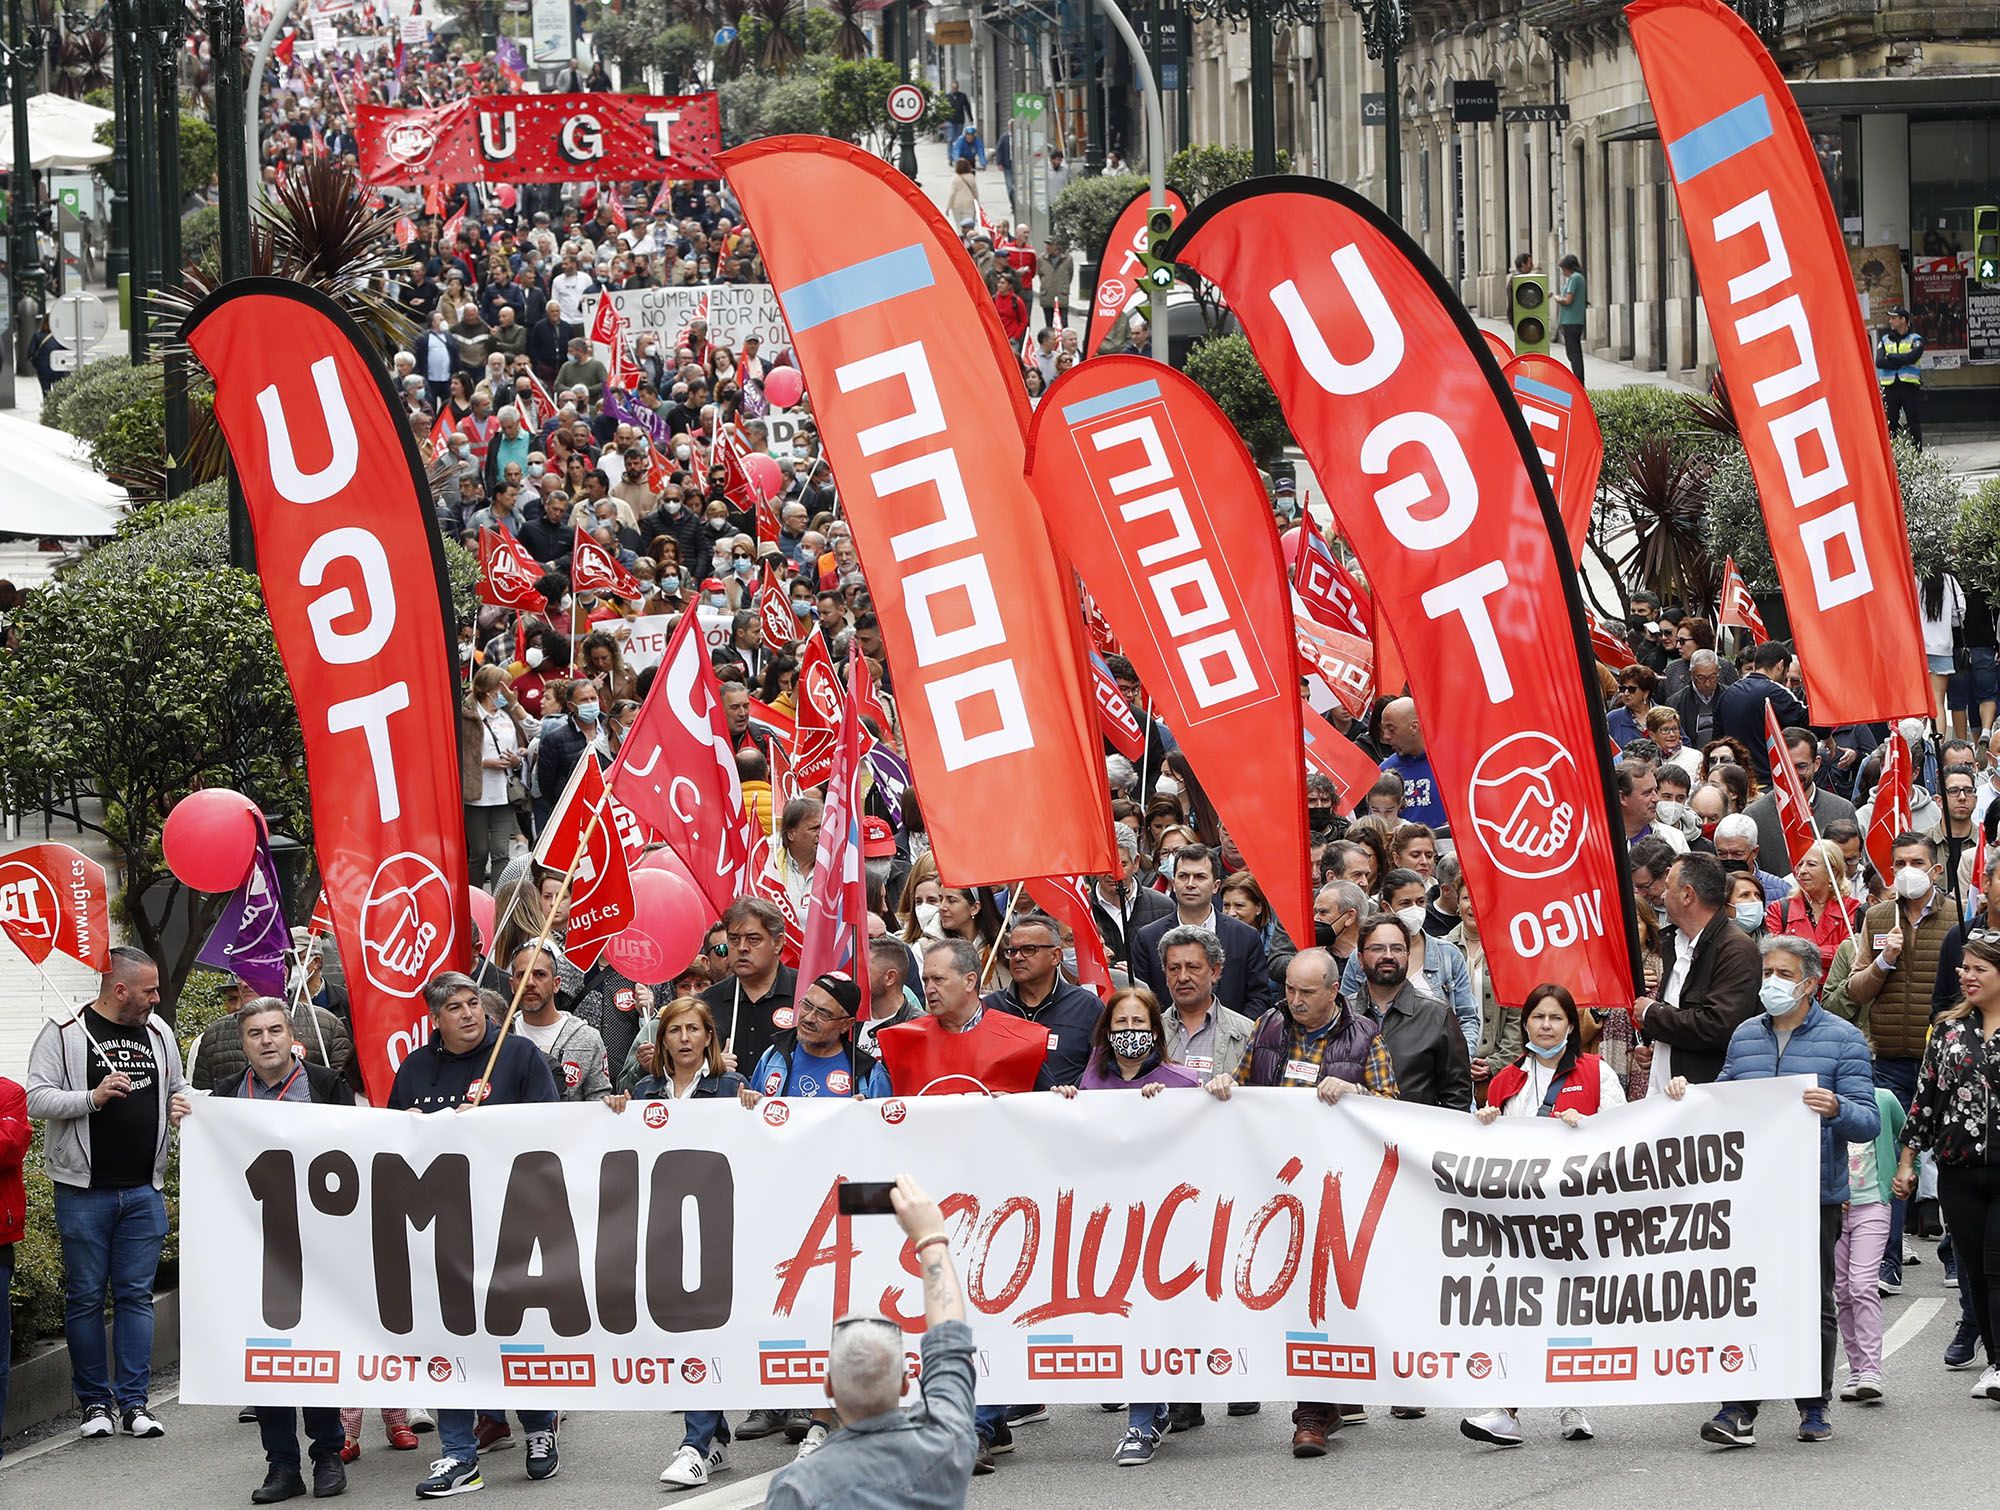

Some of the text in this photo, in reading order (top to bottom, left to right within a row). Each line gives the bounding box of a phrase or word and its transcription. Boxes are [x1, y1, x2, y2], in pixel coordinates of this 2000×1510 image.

[895, 97, 917, 109] 40
[1455, 97, 1495, 105] SEPHORA
[1505, 109, 1562, 121] ZARA
[479, 110, 681, 163] UGT
[641, 288, 755, 310] CUMPLIENTO
[641, 306, 785, 328] NO STOR NA
[1969, 316, 1981, 329] DJ
[752, 325, 791, 345] SOL
[1092, 671, 1141, 734] COO
[0, 876, 42, 924] GT
[70, 858, 92, 959] www.ugt.es
[613, 938, 653, 958] UGT
[616, 991, 636, 1004] UGT
[91, 1038, 153, 1060] NTURAL ORIGINAL
[96, 1060, 156, 1069] JENSMAKERS
[562, 1063, 580, 1078] UGT
[1187, 1060, 1212, 1069] CCOO
[1295, 1065, 1318, 1076] CCOO
[130, 1076, 153, 1091] DENIM
[829, 1073, 851, 1086] UGT
[1560, 1085, 1584, 1094] CCOO
[646, 1106, 667, 1119] UGT
[765, 1105, 790, 1118] UGT
[883, 1103, 904, 1118] UGT
[1432, 1130, 1745, 1201] SUBIR SALARIOS
[1441, 1199, 1731, 1262] CONTER PREZOS
[1440, 1262, 1758, 1327] MÁIS IGUALDADE
[250, 1346, 1714, 1384] CCOO UGT CCOO UGT CCO CCOO UGT CCOO UGT CCOO UGT
